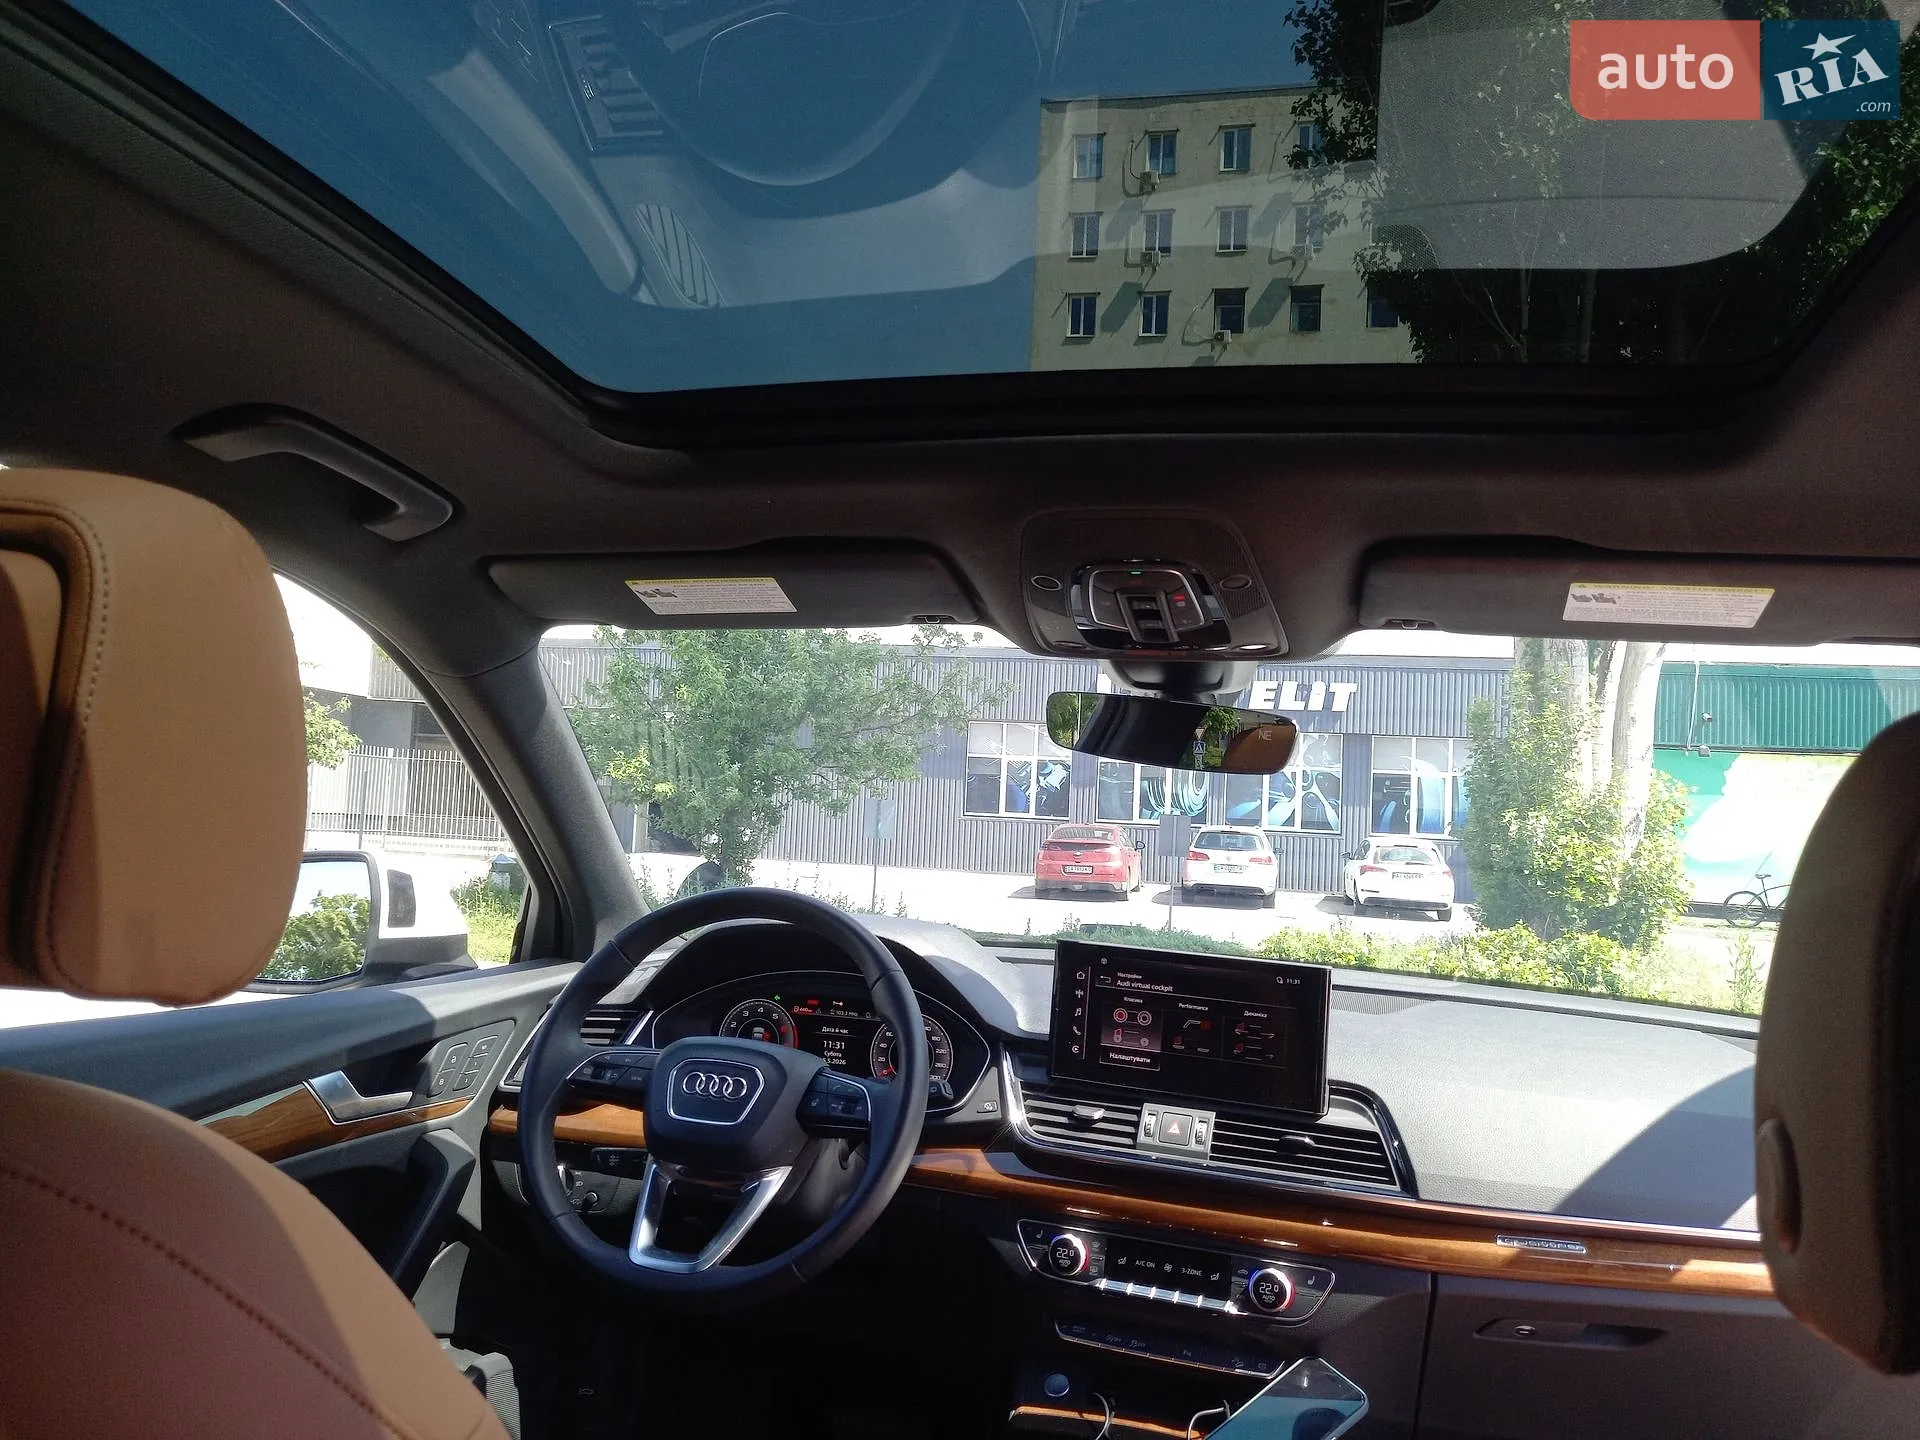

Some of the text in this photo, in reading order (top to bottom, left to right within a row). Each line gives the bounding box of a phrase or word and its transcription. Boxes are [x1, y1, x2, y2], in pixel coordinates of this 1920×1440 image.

[1116, 980, 1174, 992] Audi virtual cockpit
[823, 1040, 845, 1050] 11:31
[824, 1050, 842, 1058] Субота
